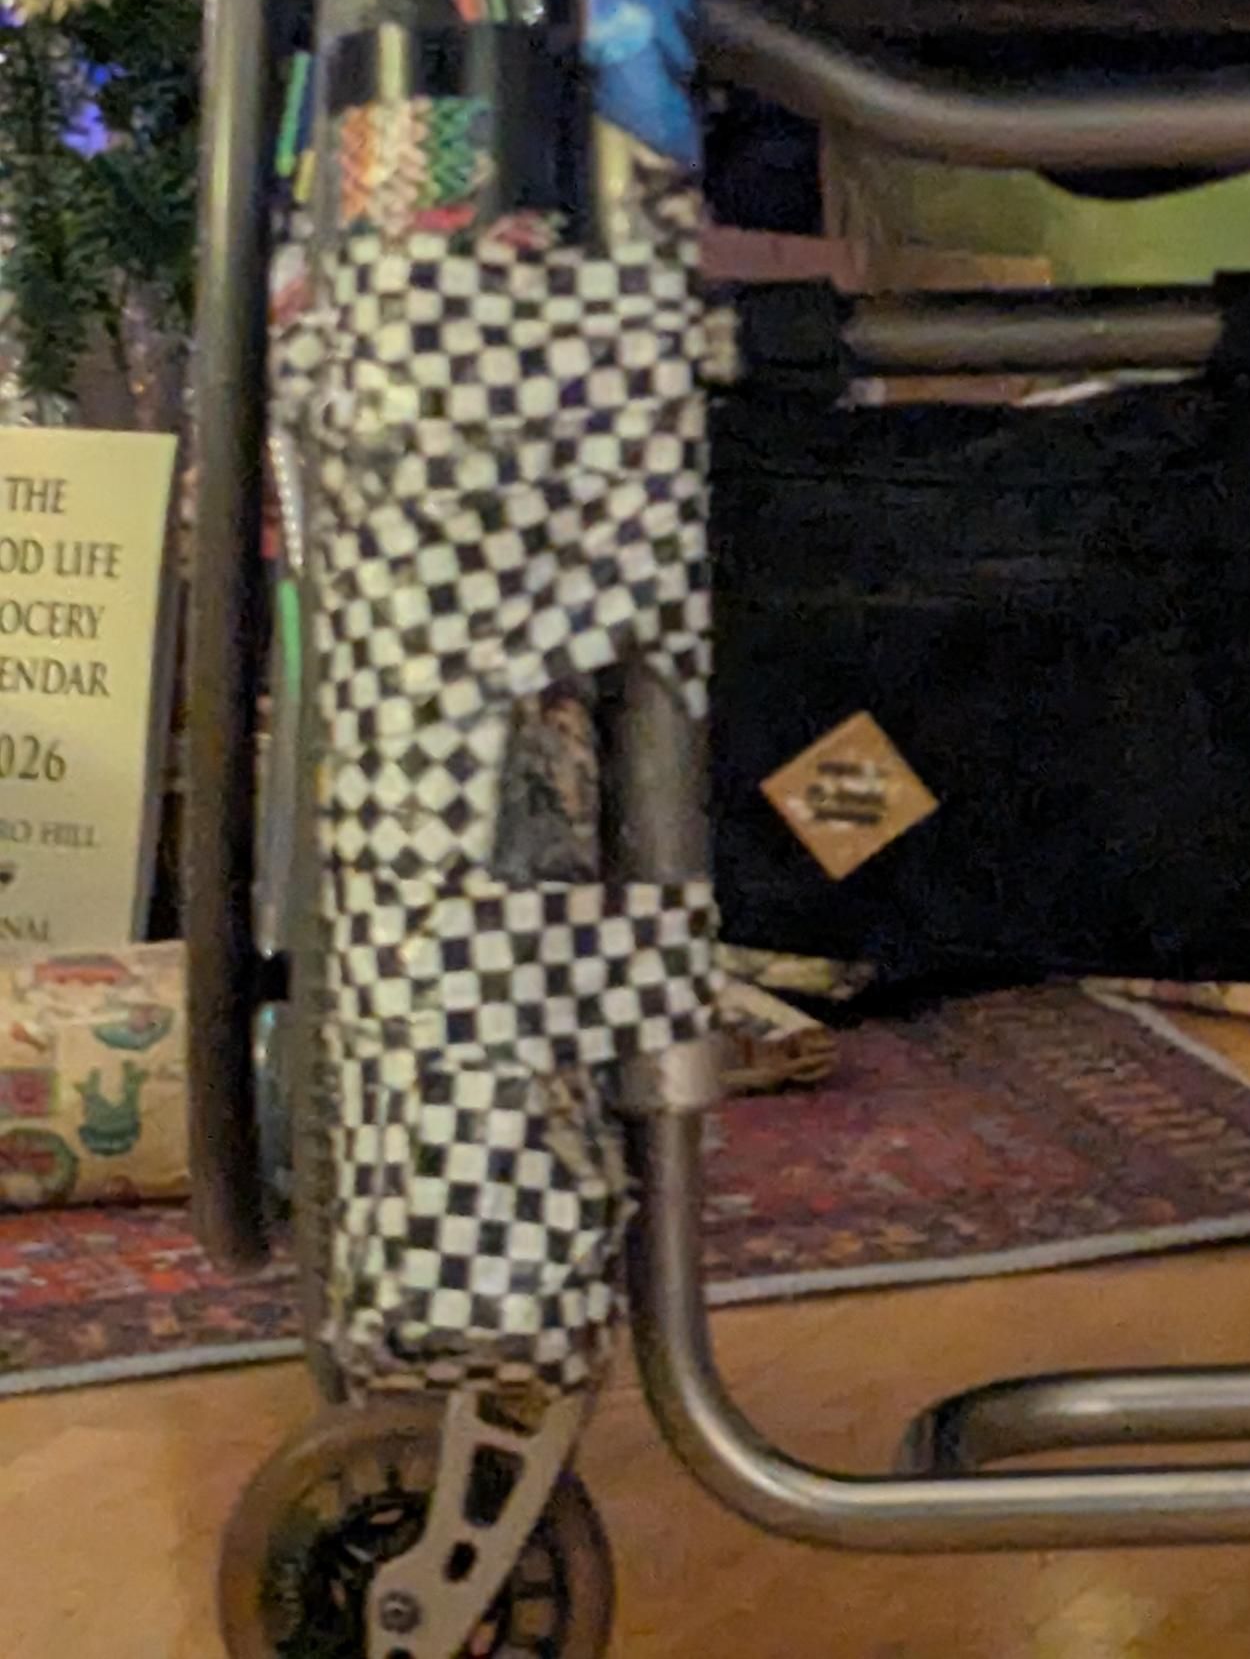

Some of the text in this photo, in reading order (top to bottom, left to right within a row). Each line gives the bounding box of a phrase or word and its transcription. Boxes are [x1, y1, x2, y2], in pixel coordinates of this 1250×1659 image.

[5, 475, 67, 514] THE
[55, 539, 123, 579] LIFE
[0, 599, 105, 639] OCERY
[0, 656, 111, 697] ENDAR
